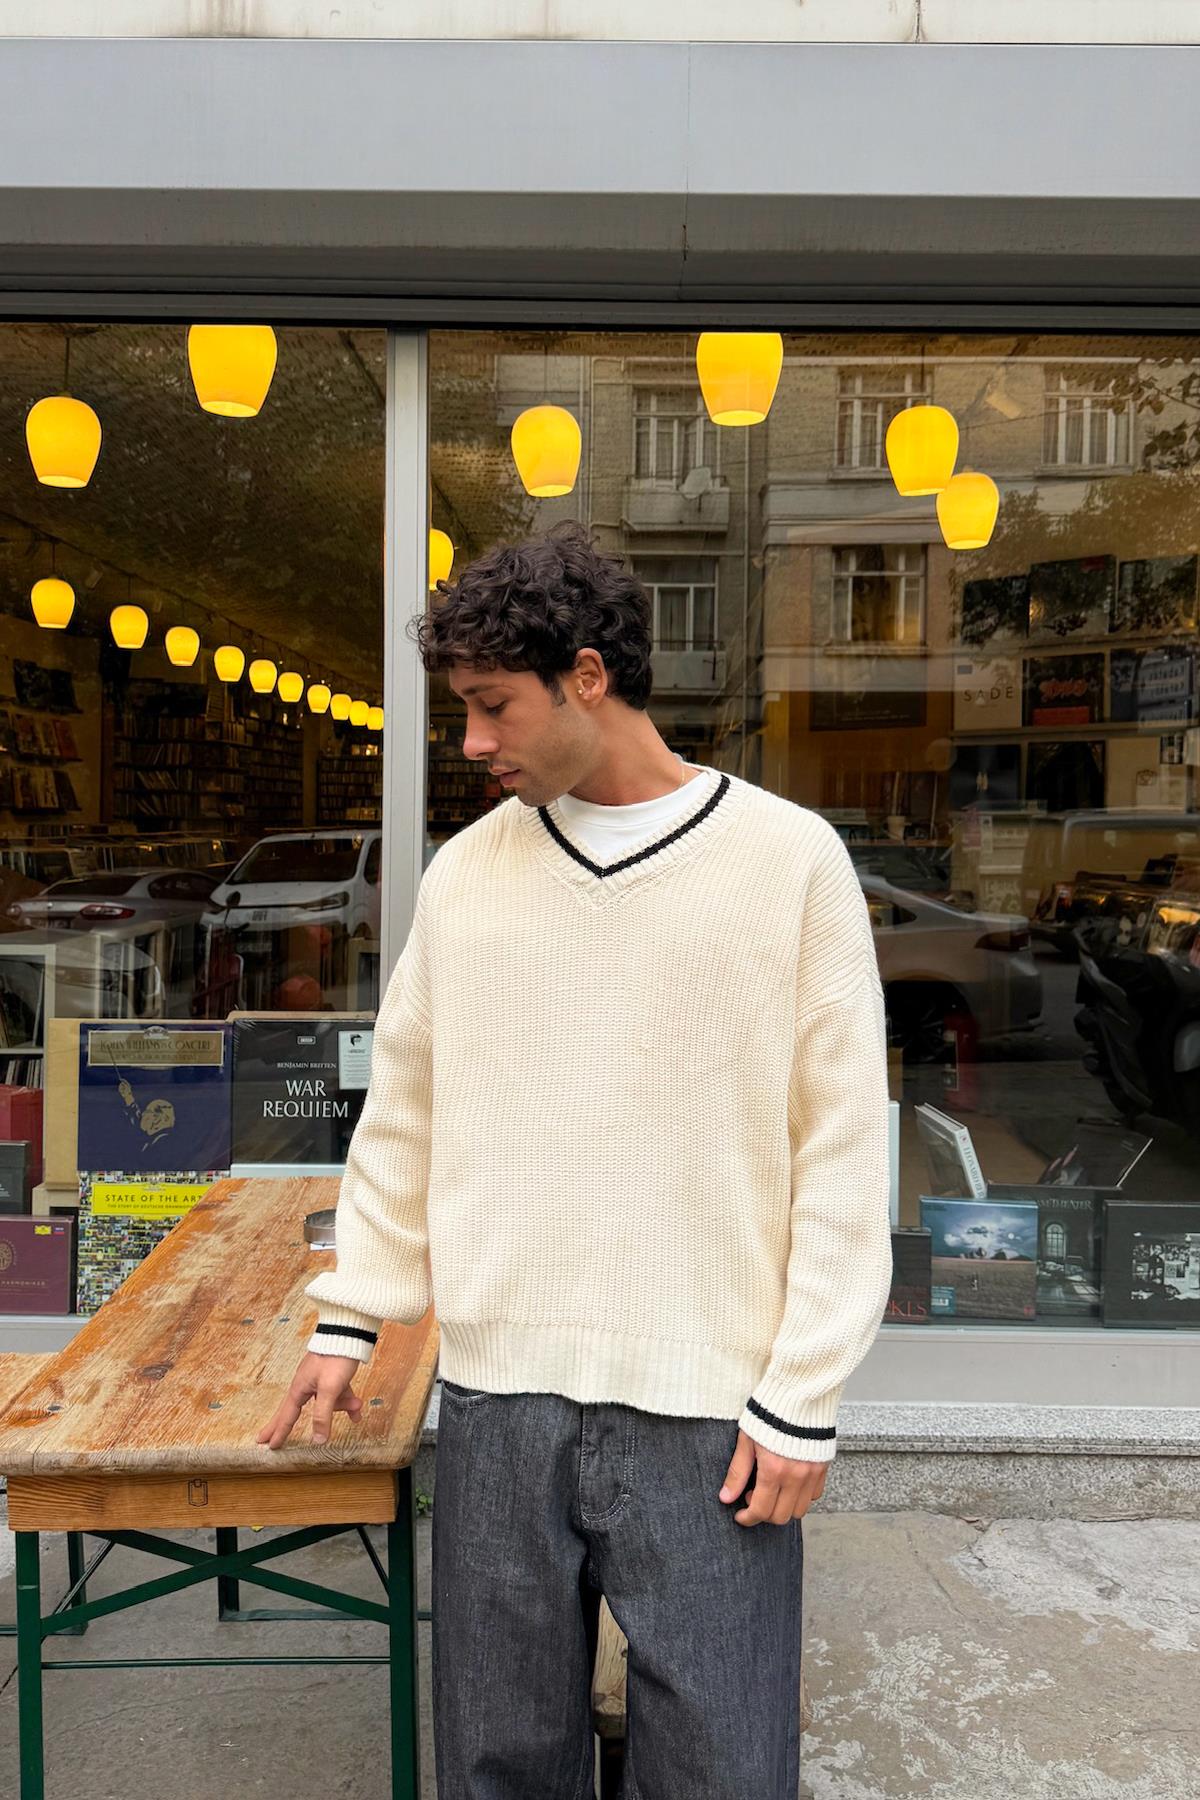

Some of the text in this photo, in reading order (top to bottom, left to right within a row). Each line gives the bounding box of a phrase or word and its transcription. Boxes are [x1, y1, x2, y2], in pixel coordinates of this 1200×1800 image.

[964, 687, 1014, 702] SADE
[285, 1079, 327, 1097] WAR
[263, 1100, 349, 1118] REQUIEM
[105, 1194, 136, 1203] STATE
[140, 1194, 153, 1203] OF
[159, 1194, 178, 1203] THE
